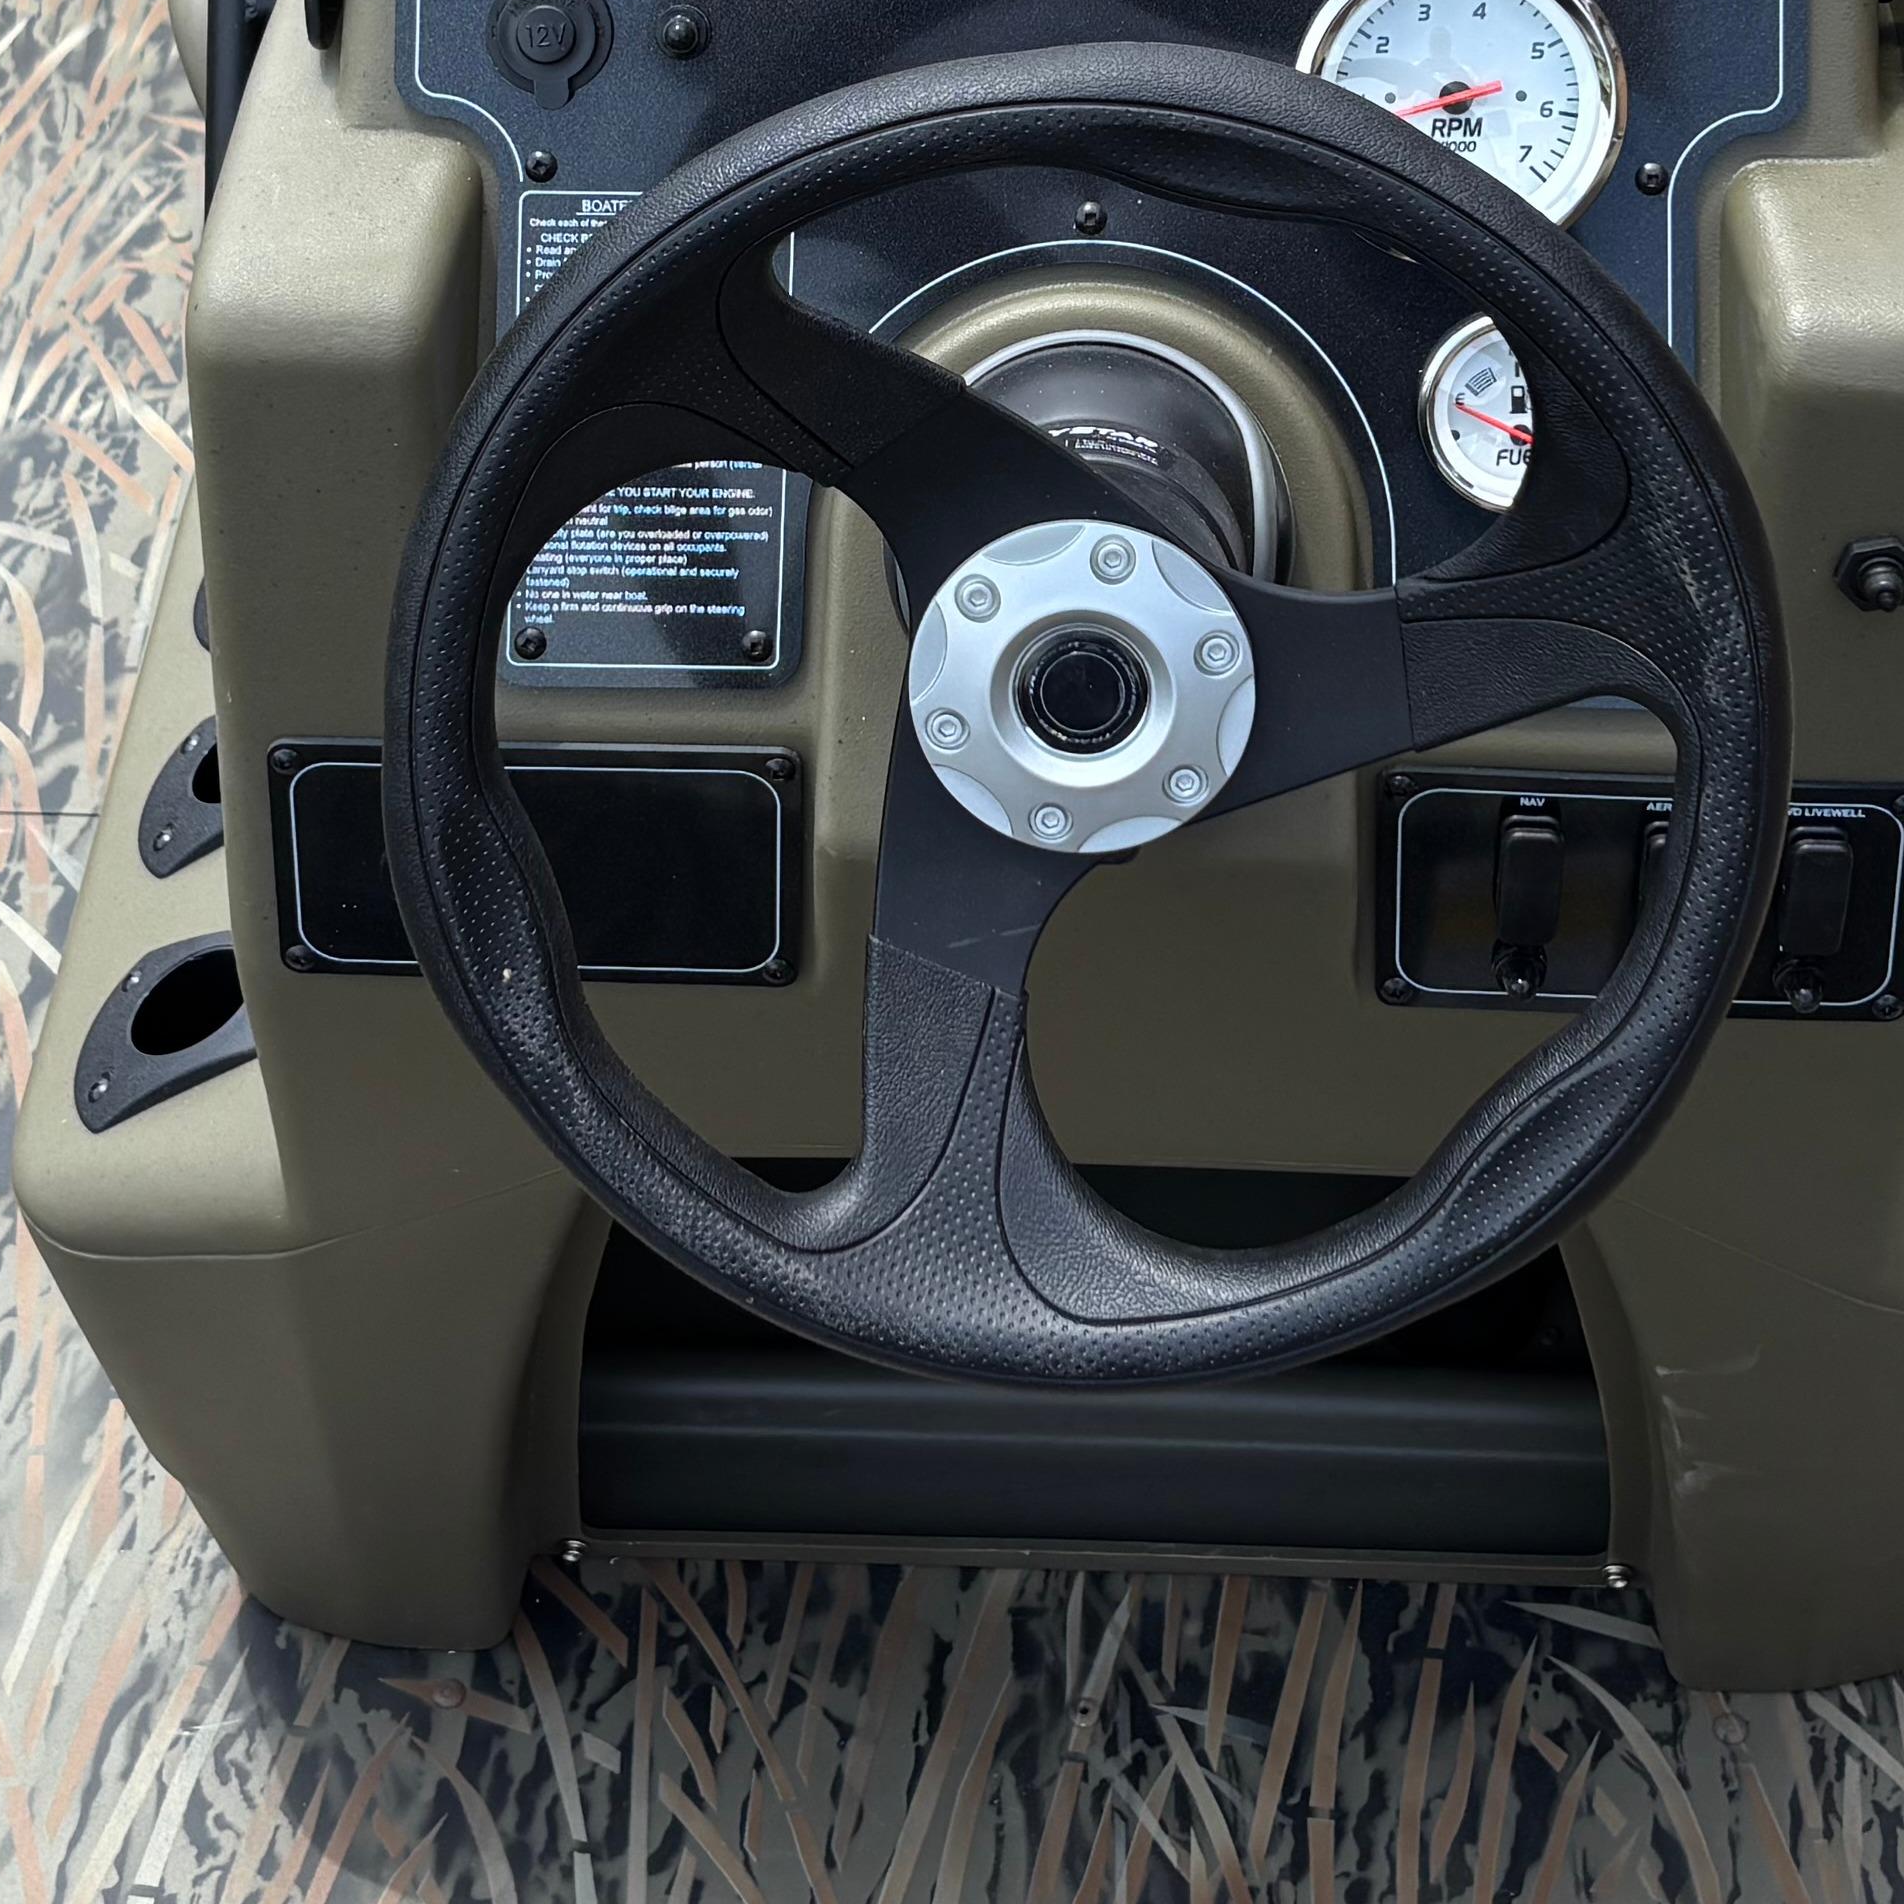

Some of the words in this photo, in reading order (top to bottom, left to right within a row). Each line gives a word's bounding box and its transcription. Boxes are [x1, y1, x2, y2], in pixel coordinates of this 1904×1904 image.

[1417, 4, 1432, 22] 3
[1472, 1, 1487, 20] 4
[524, 23, 568, 48] 12V
[1375, 36, 1390, 54] 2
[1531, 41, 1545, 60] 5
[1539, 100, 1554, 118] 6
[1431, 117, 1483, 138] RPM
[1518, 145, 1533, 163] 7
[582, 199, 633, 212] BOATE
[529, 218, 556, 227] Check
[558, 218, 579, 227] each
[580, 218, 589, 227] of
[540, 233, 578, 243] CHECK
[536, 245, 561, 255] Read
[535, 257, 561, 267] Drain
[1496, 448, 1532, 466] FUE
[617, 487, 641, 497] YOU
[642, 487, 676, 498] START
[679, 487, 709, 498] YOUR
[599, 503, 612, 513] for
[634, 504, 662, 514] check
[664, 504, 687, 516] bilge
[689, 506, 711, 515] area
[713, 505, 726, 515] for
[728, 507, 746, 517] gas
[575, 516, 608, 525] neutral
[571, 528, 594, 539] plate
[617, 530, 635, 540] you
[637, 529, 690, 539] overloaded
[692, 530, 702, 539] or
[610, 541, 647, 551] devices
[648, 543, 661, 551] on
[663, 542, 675, 551] all
[614, 553, 623, 562] in
[625, 555, 656, 565] proper
[566, 566, 587, 576] stop
[589, 565, 619, 575] switch
[679, 566, 698, 576] and
[699, 567, 740, 579] securely
[525, 589, 539, 599] No
[541, 591, 560, 599] one
[562, 589, 571, 599] in
[572, 590, 599, 599] water
[601, 591, 623, 599] near
[525, 602, 550, 613] Keep
[552, 603, 559, 612] a
[560, 601, 579, 611] firm
[581, 602, 600, 612] and
[601, 603, 653, 613] continuous
[654, 603, 673, 615] grip
[675, 605, 687, 613] on
[689, 603, 705, 614] the
[707, 604, 745, 616] steering
[1519, 796, 1546, 807] NAV
[1646, 801, 1673, 812] AER
[1804, 807, 1866, 818] LIVEWELL
